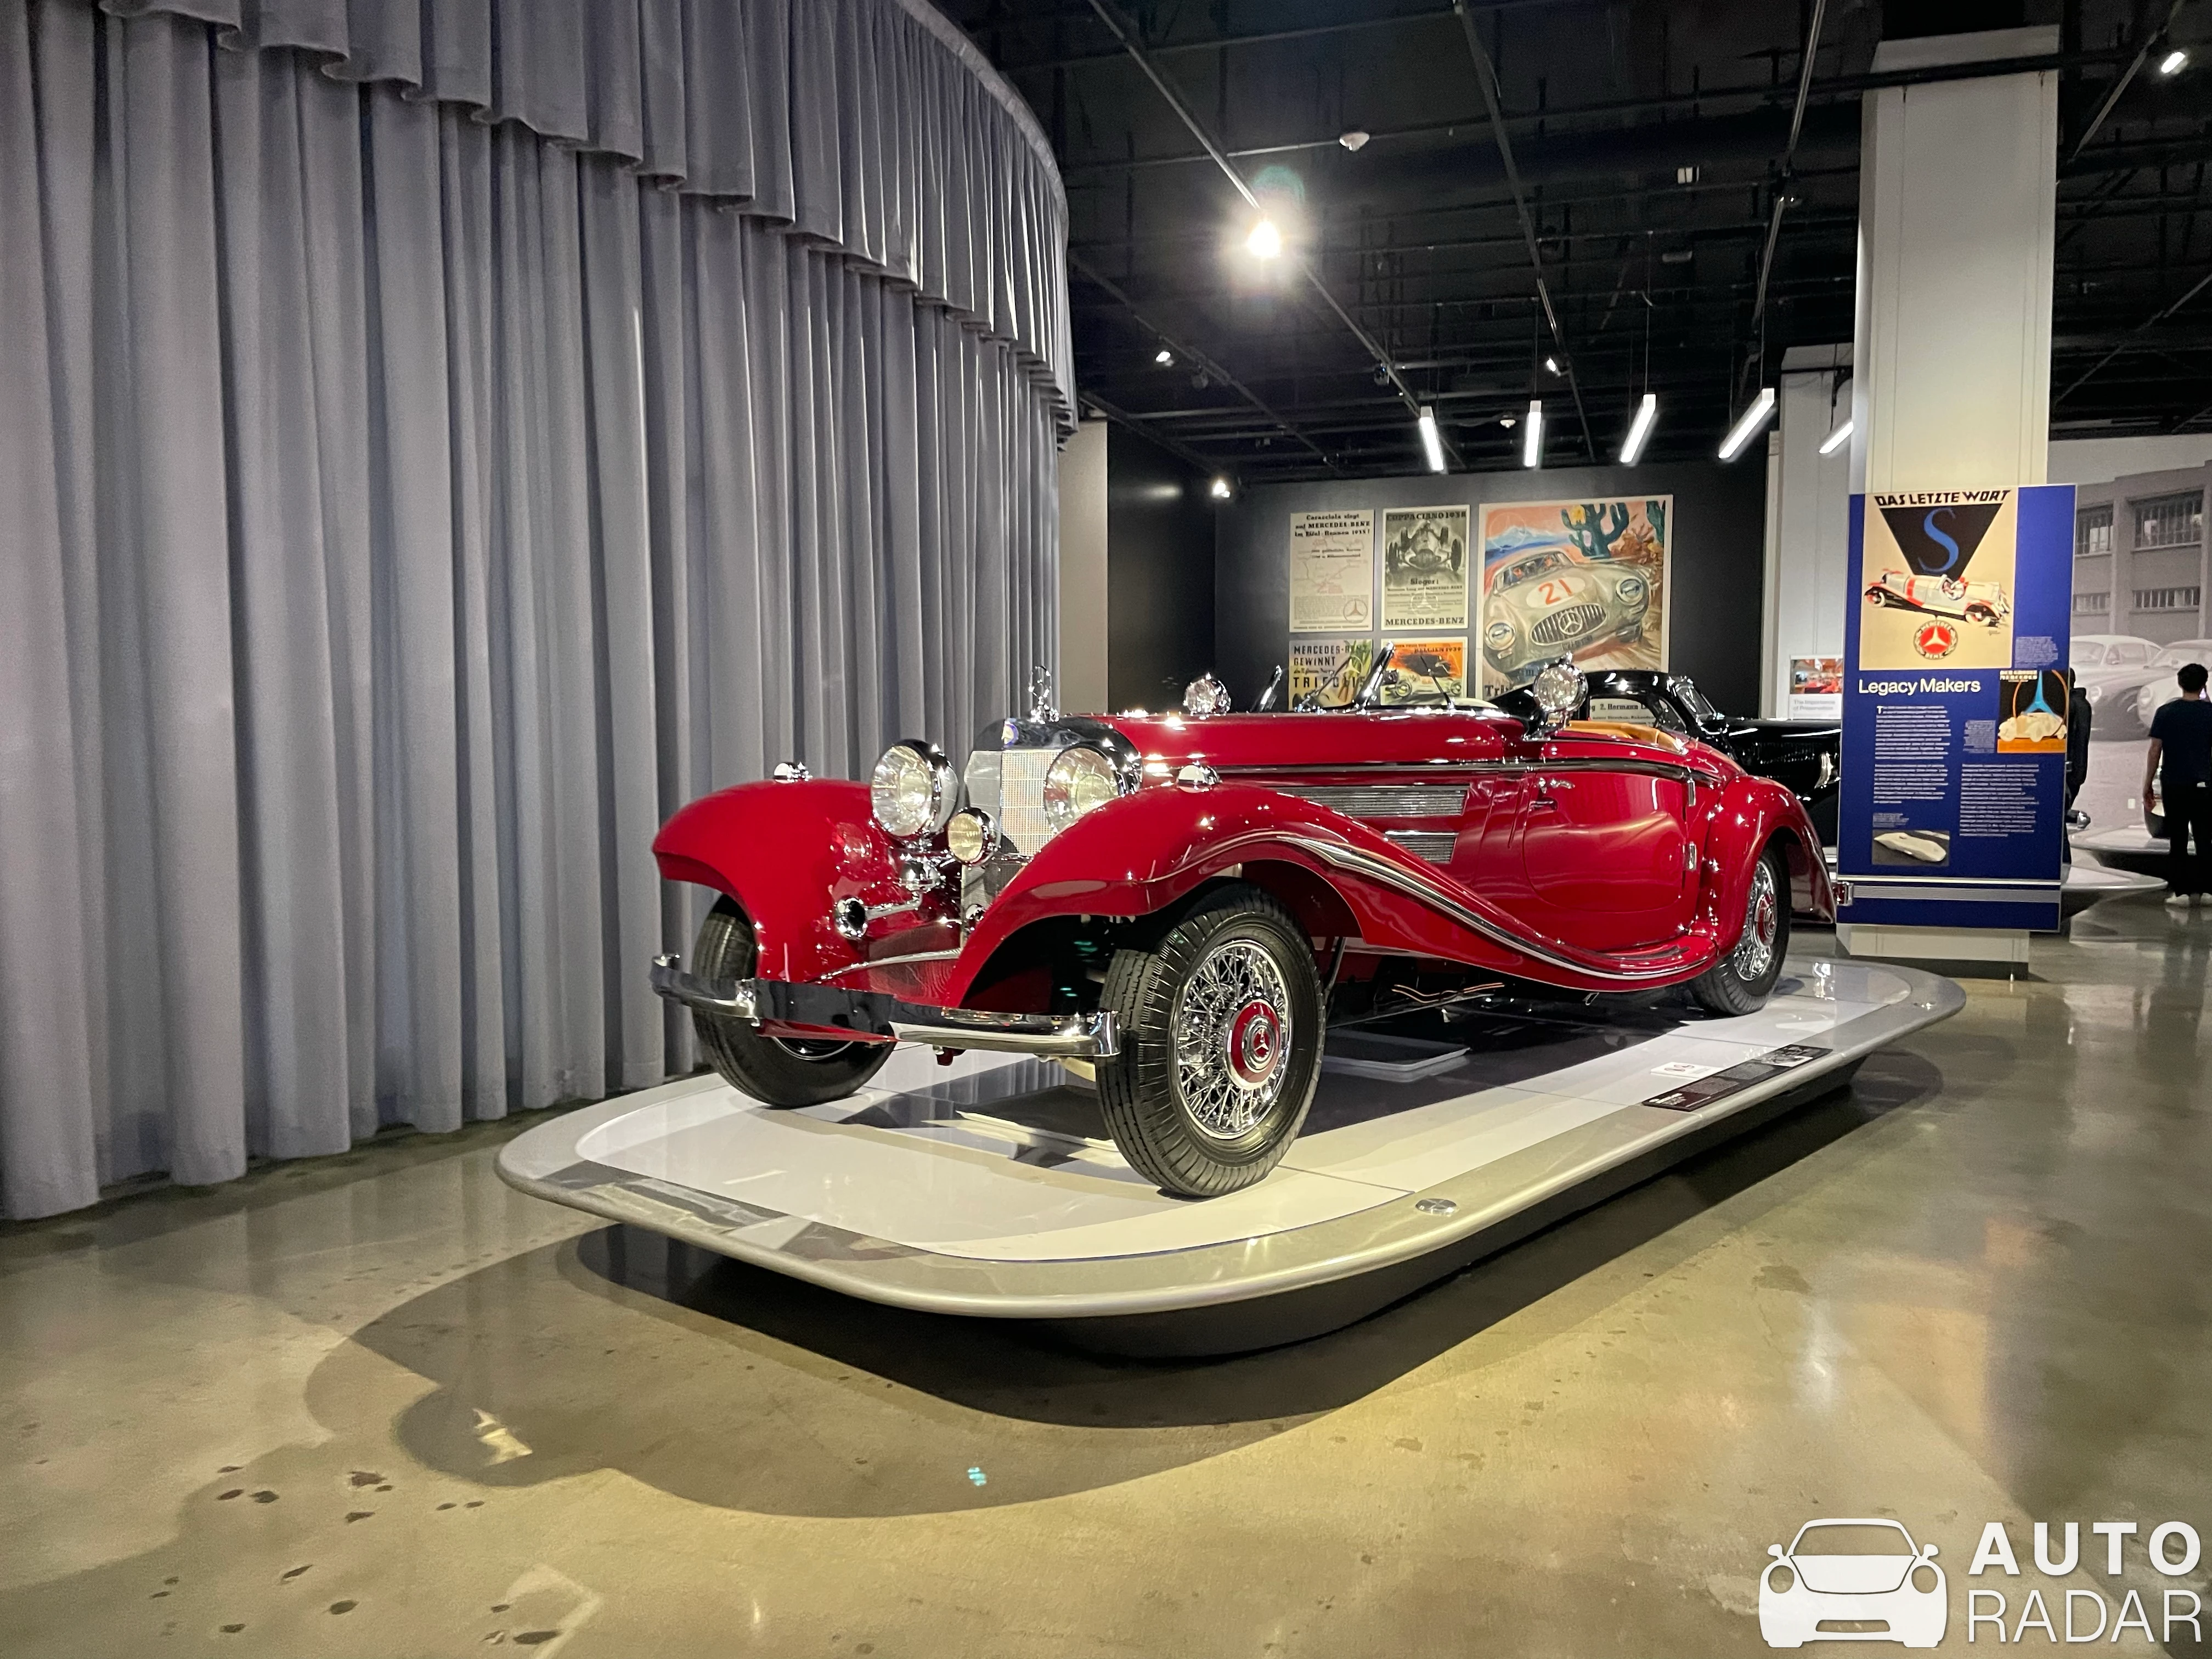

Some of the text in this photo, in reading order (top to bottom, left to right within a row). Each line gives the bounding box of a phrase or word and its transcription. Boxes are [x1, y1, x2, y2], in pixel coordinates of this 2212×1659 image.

[1874, 489, 2012, 506] DAS LETZTE WORT
[1917, 507, 1959, 573] S
[1538, 578, 1573, 606] 21
[1294, 656, 1335, 667] GEWINNT
[1858, 678, 1982, 696] Legacy Makers
